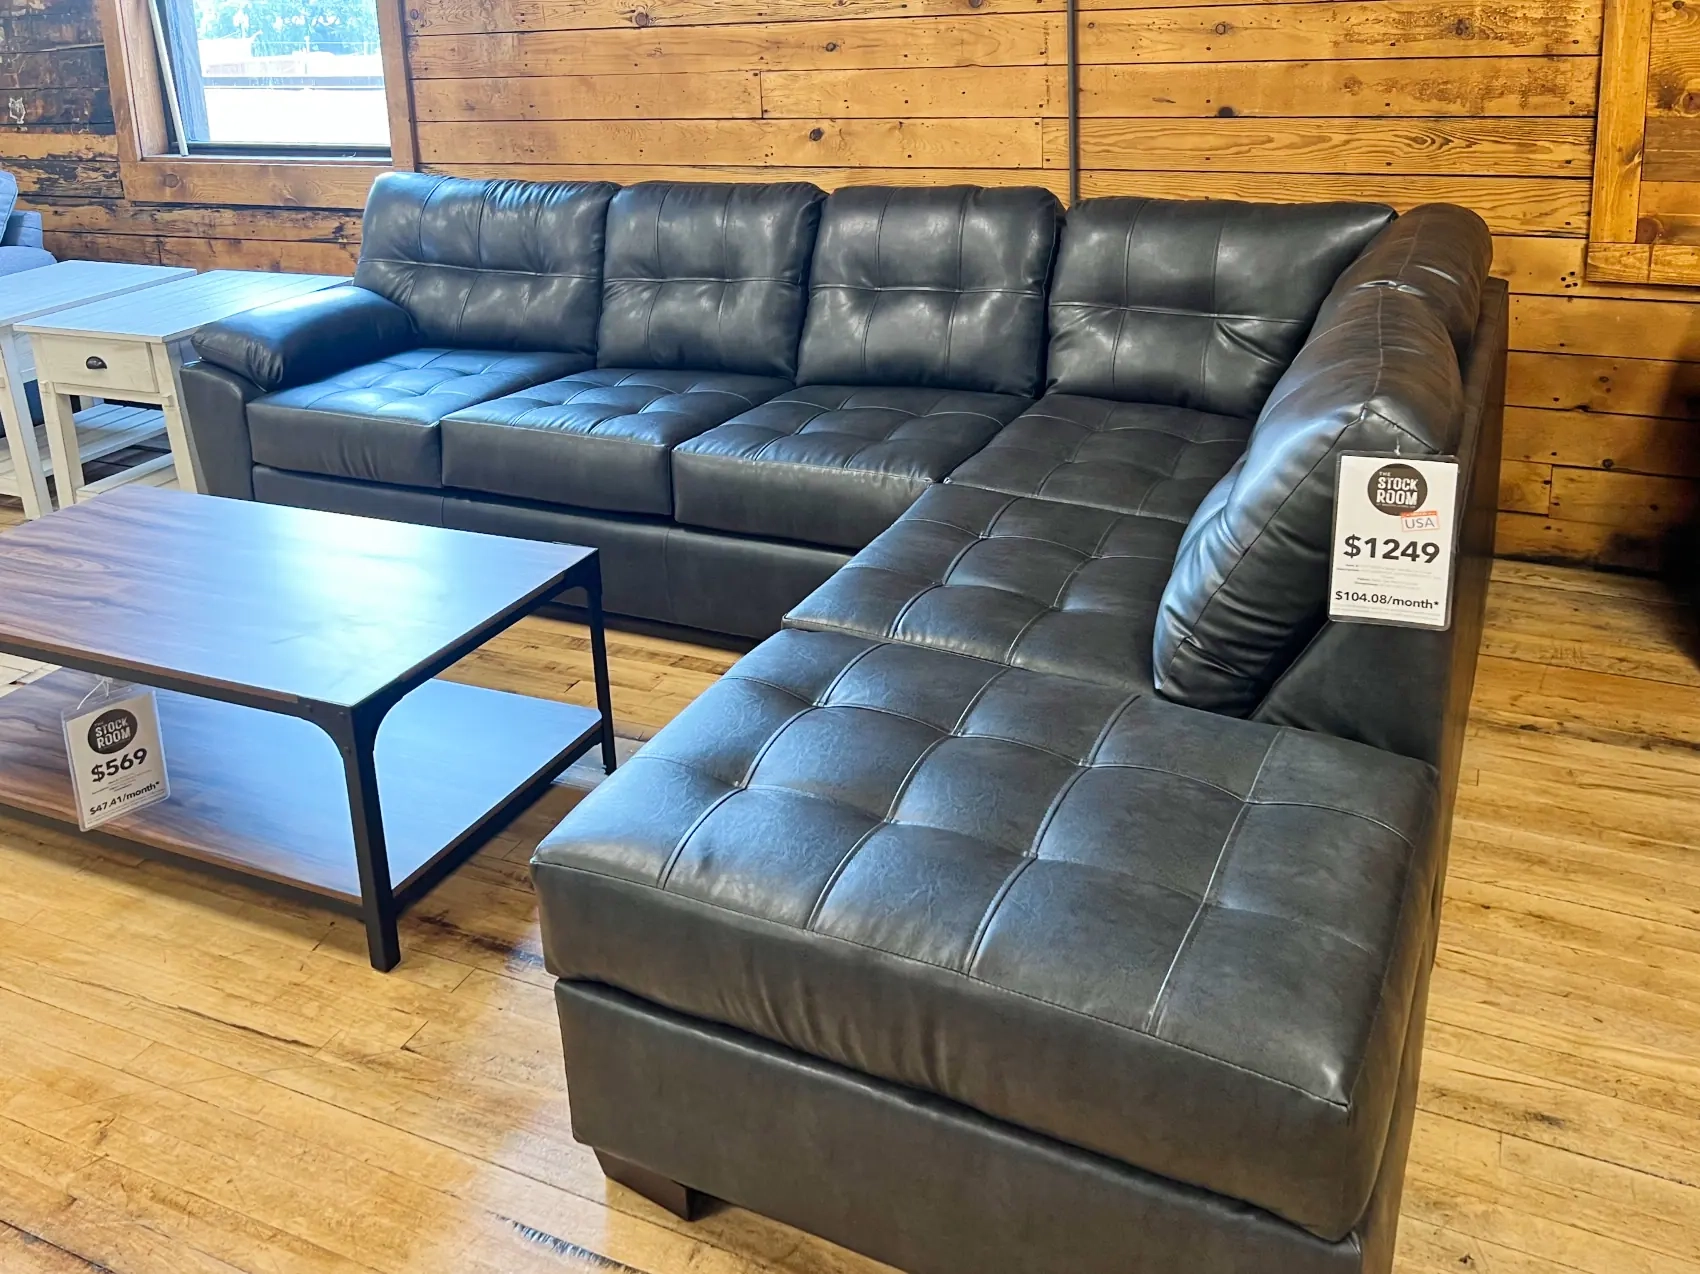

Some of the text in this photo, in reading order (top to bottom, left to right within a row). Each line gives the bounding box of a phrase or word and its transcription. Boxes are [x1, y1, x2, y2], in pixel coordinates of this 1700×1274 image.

[1377, 477, 1418, 491] STOCK
[1376, 490, 1418, 506] ROOM
[1405, 517, 1435, 529] USA
[1343, 534, 1440, 564] $1249
[95, 716, 128, 737] STOCK
[96, 726, 131, 749] ROOM
[91, 748, 147, 782] $569
